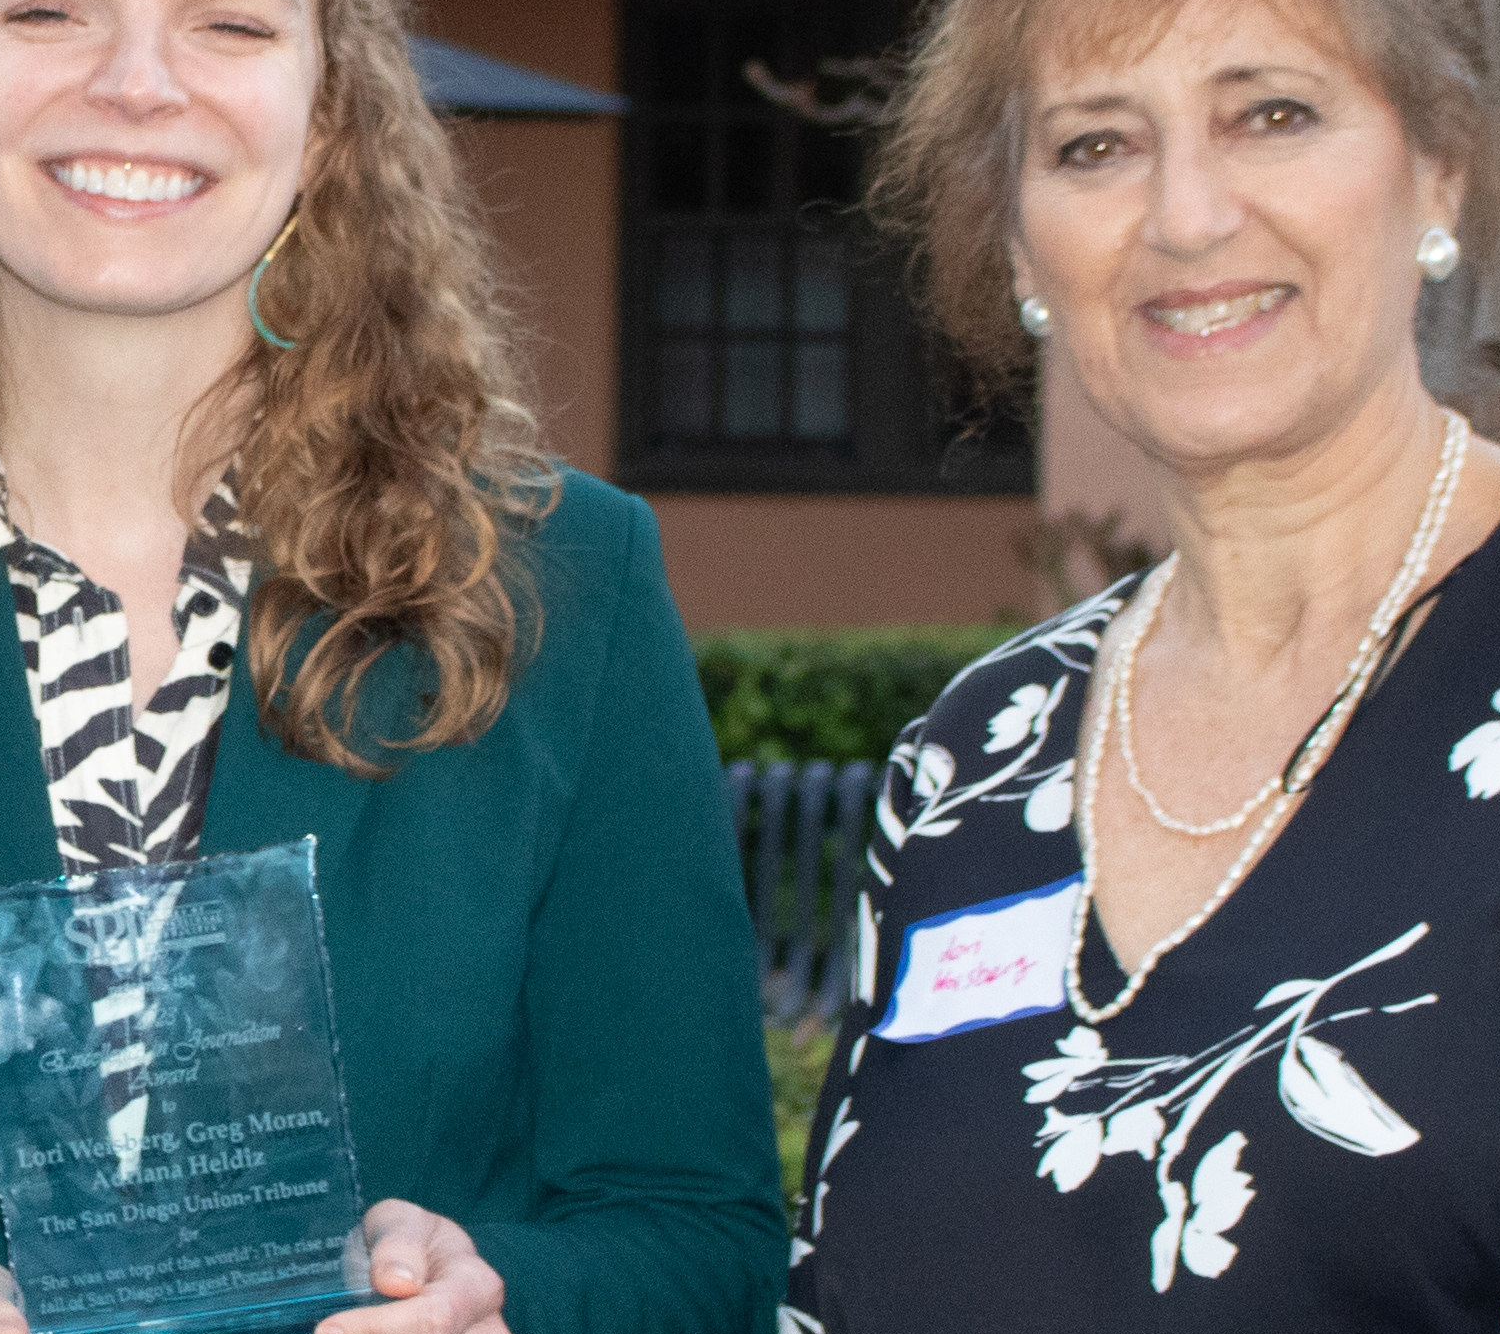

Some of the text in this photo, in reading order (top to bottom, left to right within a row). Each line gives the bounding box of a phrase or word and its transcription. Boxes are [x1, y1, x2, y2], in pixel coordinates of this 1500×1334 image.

[161, 1099, 177, 1114] to
[16, 1142, 64, 1168] Lori
[186, 1121, 245, 1143] Greg
[248, 1109, 330, 1134] Moran,
[187, 1147, 266, 1176] Heldiz
[38, 1179, 329, 1234] The San Diego Union-Tribune
[105, 1268, 127, 1282] on
[129, 1264, 155, 1281] top
[156, 1257, 174, 1274] of
[176, 1254, 200, 1270] the
[260, 1241, 292, 1259] The
